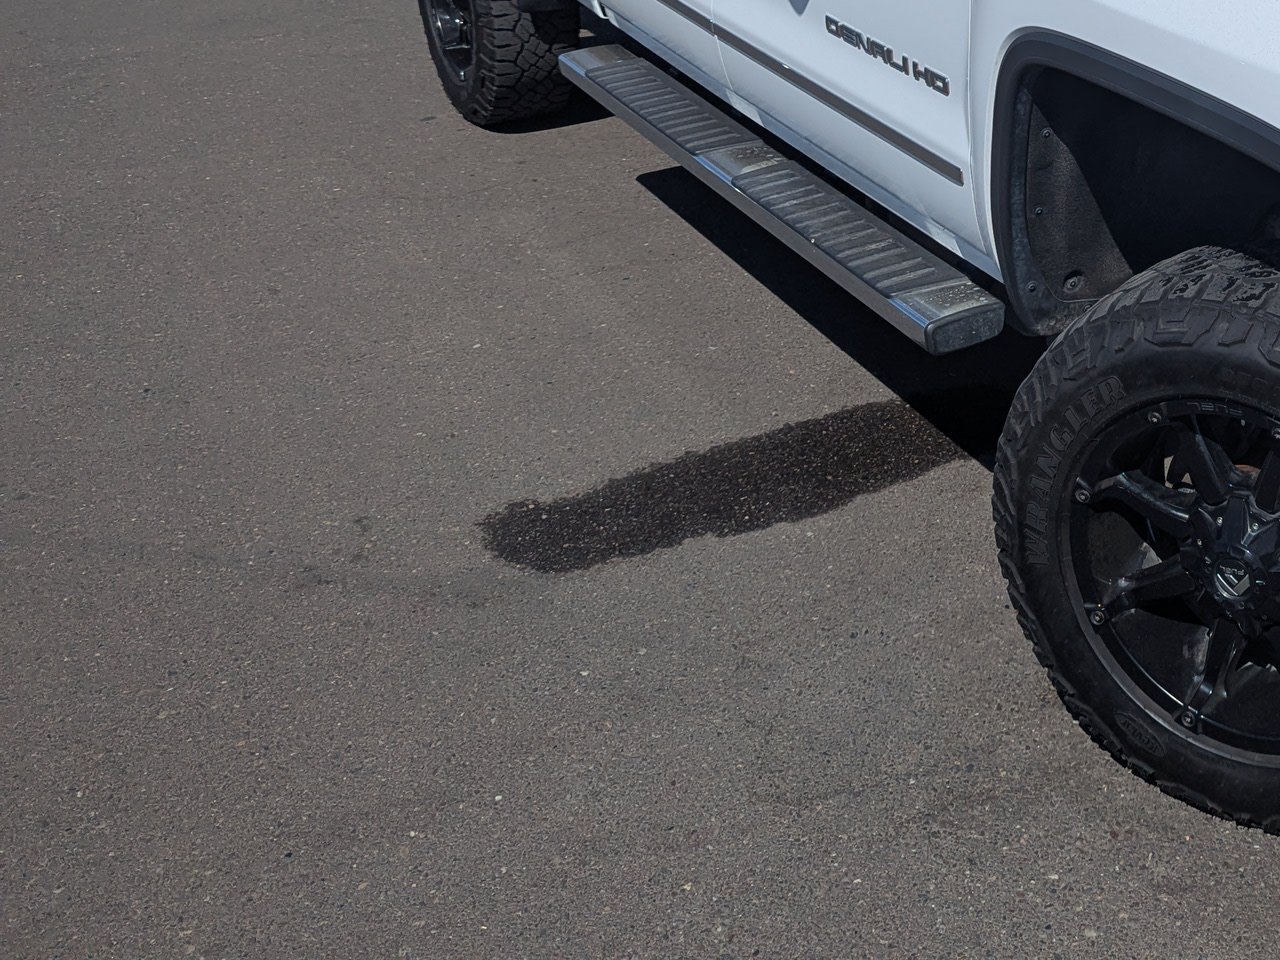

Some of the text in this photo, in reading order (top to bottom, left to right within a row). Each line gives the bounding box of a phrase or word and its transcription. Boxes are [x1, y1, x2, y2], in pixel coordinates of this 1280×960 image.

[825, 13, 950, 97] DENALI HD
[1024, 375, 1126, 568] WRANGLER
